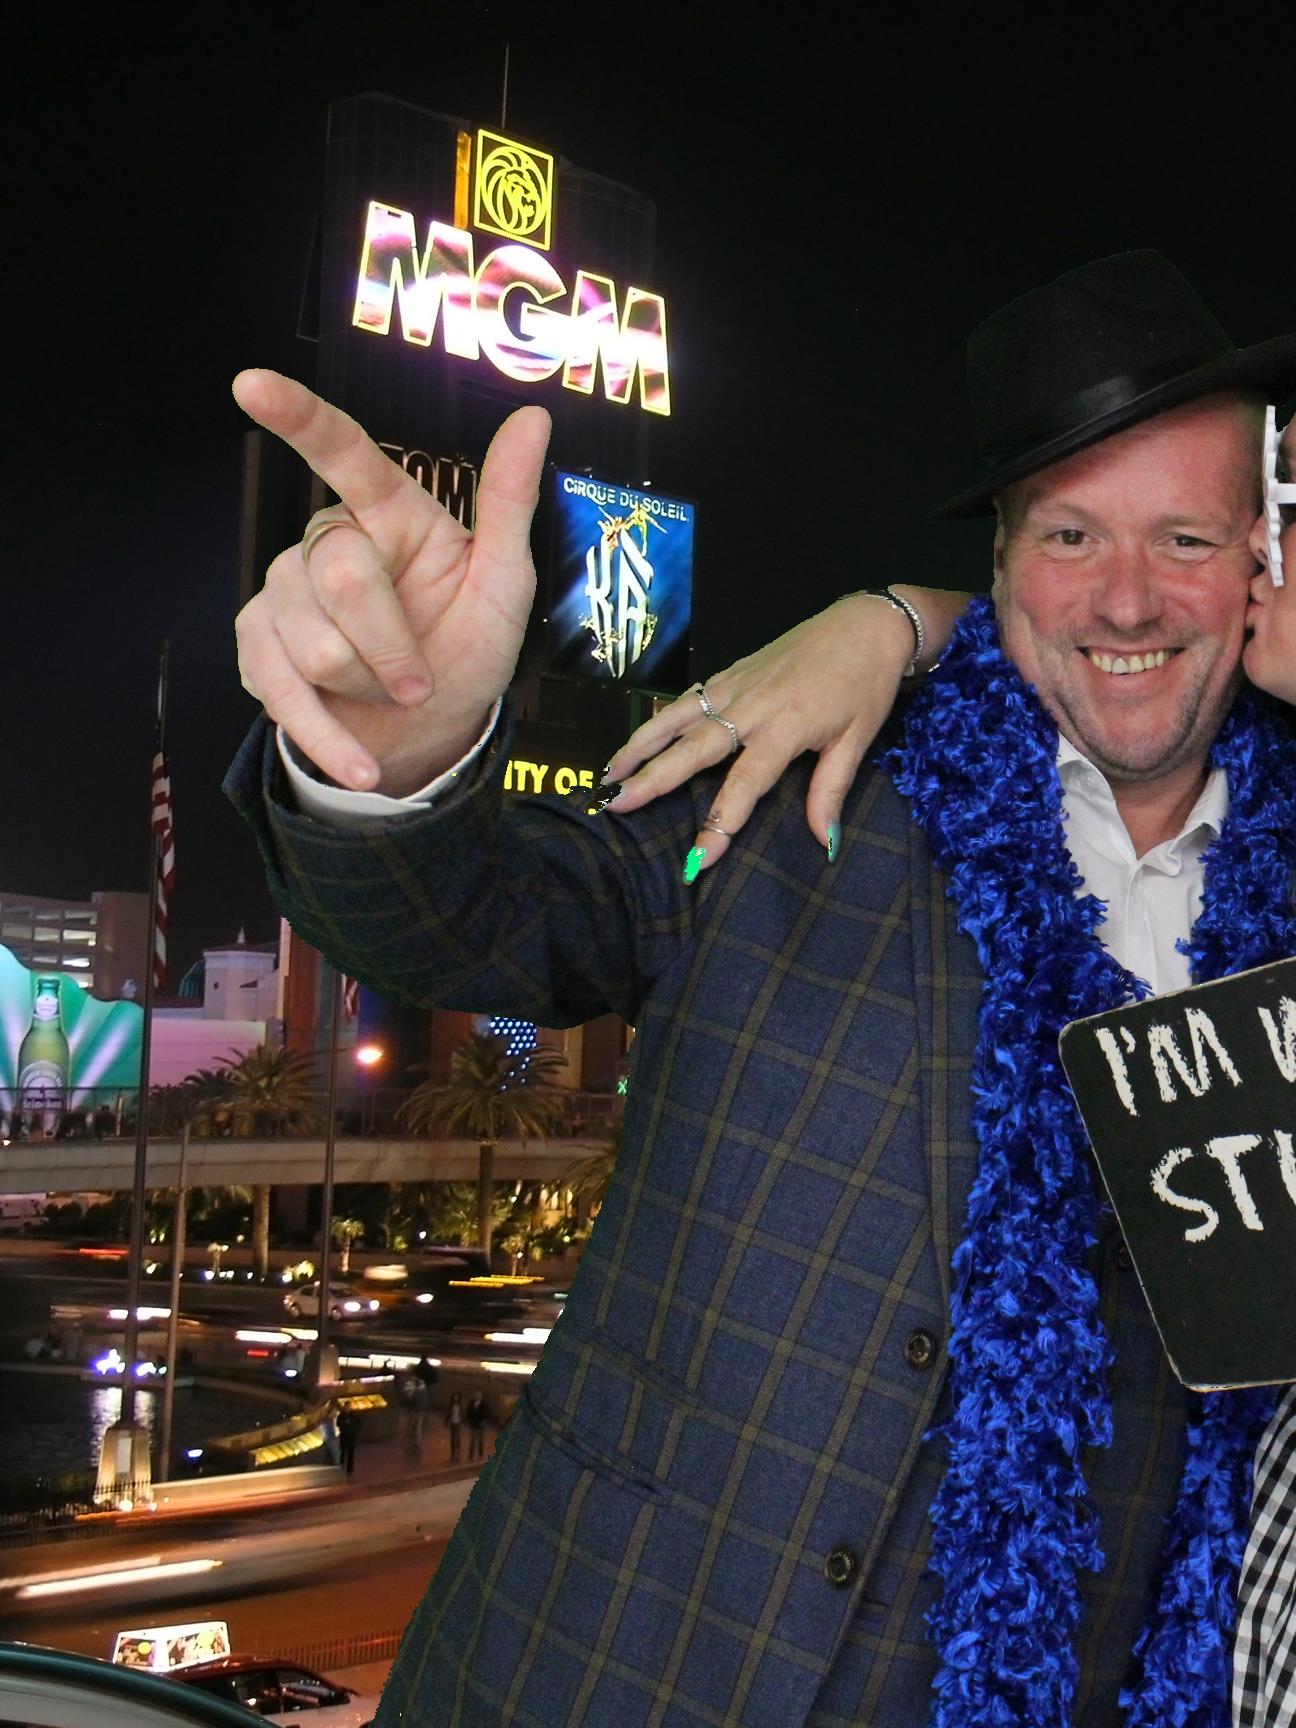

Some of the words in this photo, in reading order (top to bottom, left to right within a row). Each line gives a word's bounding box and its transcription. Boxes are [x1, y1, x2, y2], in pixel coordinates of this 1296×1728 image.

[352, 200, 671, 416] MGM
[619, 491, 639, 509] DU
[1095, 1007, 1243, 1117] I'M
